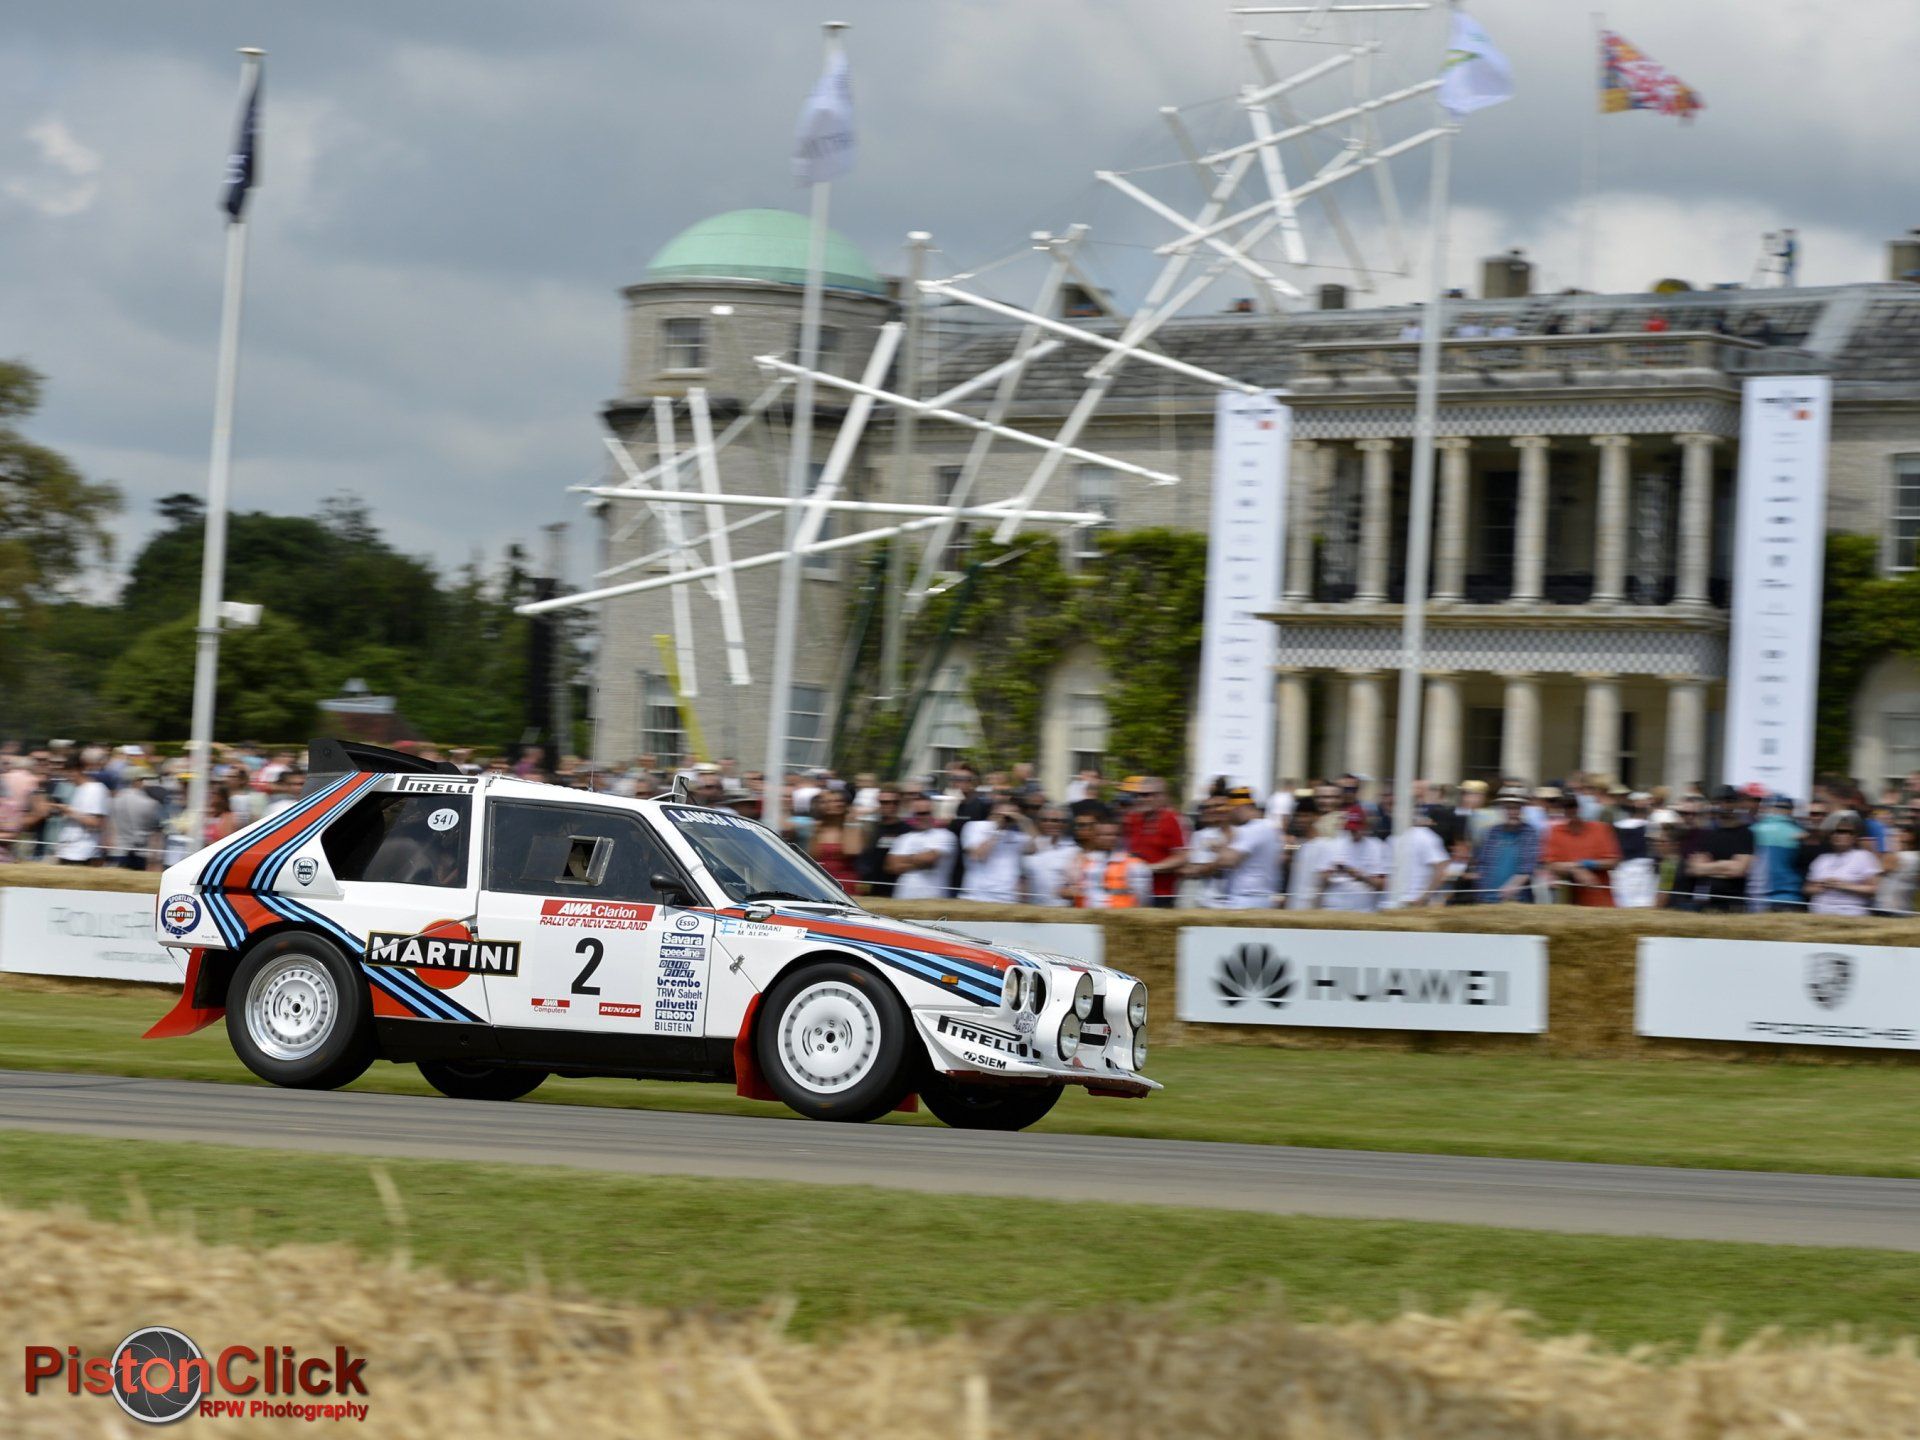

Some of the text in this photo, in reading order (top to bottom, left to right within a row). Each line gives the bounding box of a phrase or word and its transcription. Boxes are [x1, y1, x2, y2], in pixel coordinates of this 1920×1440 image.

[397, 775, 479, 794] PIRELLI
[433, 814, 453, 825] 541
[668, 809, 733, 827] LANCIA
[557, 902, 637, 919] AWA-Clarion
[540, 916, 648, 931] RALLY OF NEW ZEALAND
[663, 932, 703, 945] Savara
[372, 936, 515, 971] MARTINI
[660, 948, 700, 958] speedline
[571, 937, 604, 996] 2
[660, 960, 690, 969] OLIO
[664, 969, 695, 978] FIAT
[657, 977, 701, 988] brembo
[1306, 965, 1509, 1006] HUAWEI
[657, 987, 702, 1000] TRW Sabelt
[533, 1006, 567, 1014] Computers
[600, 1006, 640, 1014] DUNLOP
[656, 999, 698, 1010] olivetti
[656, 1010, 693, 1020] FERODO
[655, 1022, 692, 1032] BILSTEIN
[1748, 1020, 1915, 1042] PORSCHE
[937, 1015, 1022, 1055] PIRELLI
[978, 1055, 1007, 1069] SIEM
